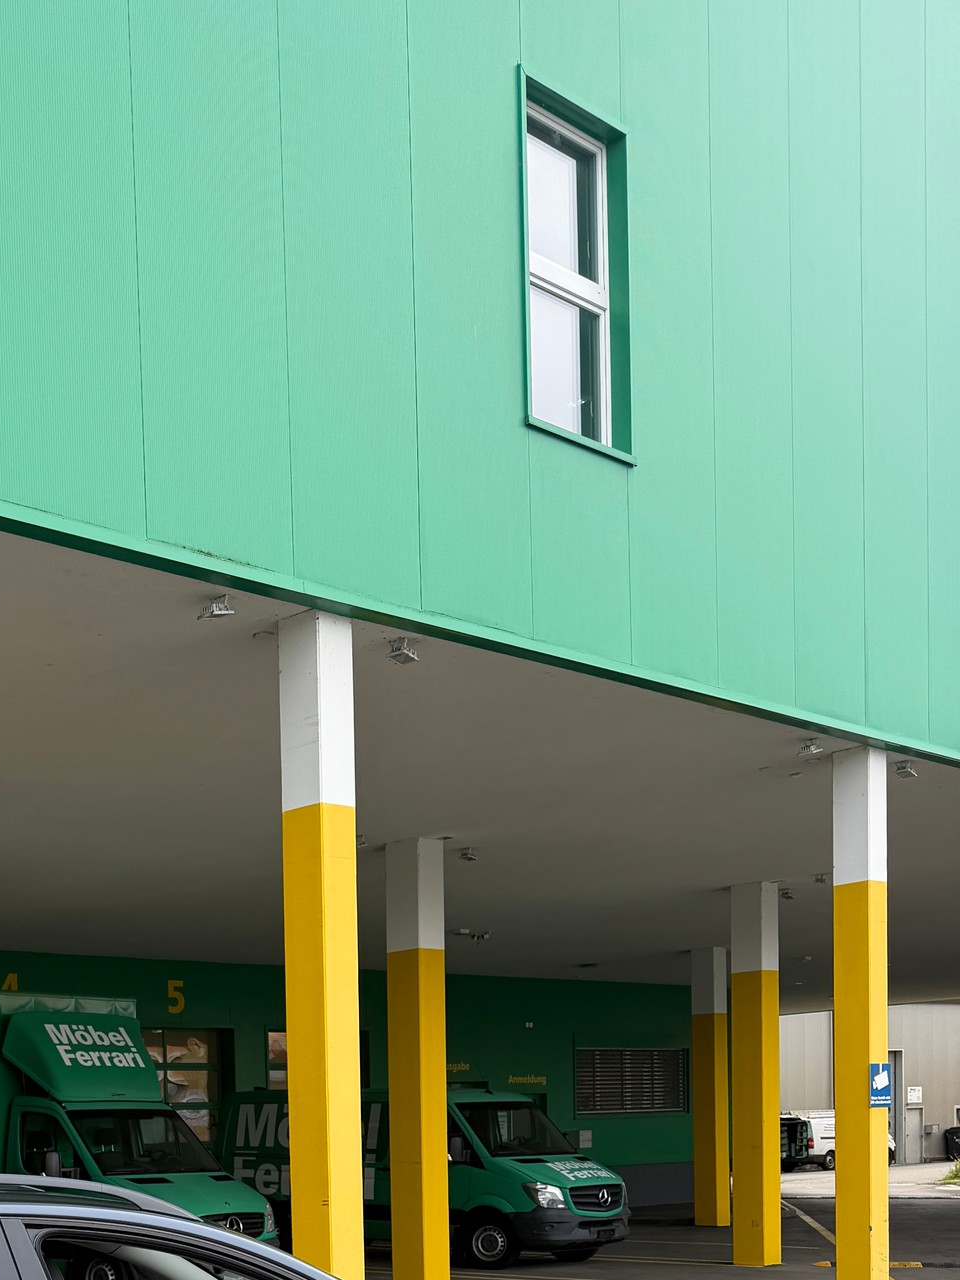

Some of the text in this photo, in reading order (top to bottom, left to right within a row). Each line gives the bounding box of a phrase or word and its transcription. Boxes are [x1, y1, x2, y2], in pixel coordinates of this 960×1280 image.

[167, 980, 185, 1014] 5
[44, 1023, 133, 1047] Möbel
[55, 1045, 145, 1068] Ferrari
[508, 1074, 547, 1085] Anmeldung
